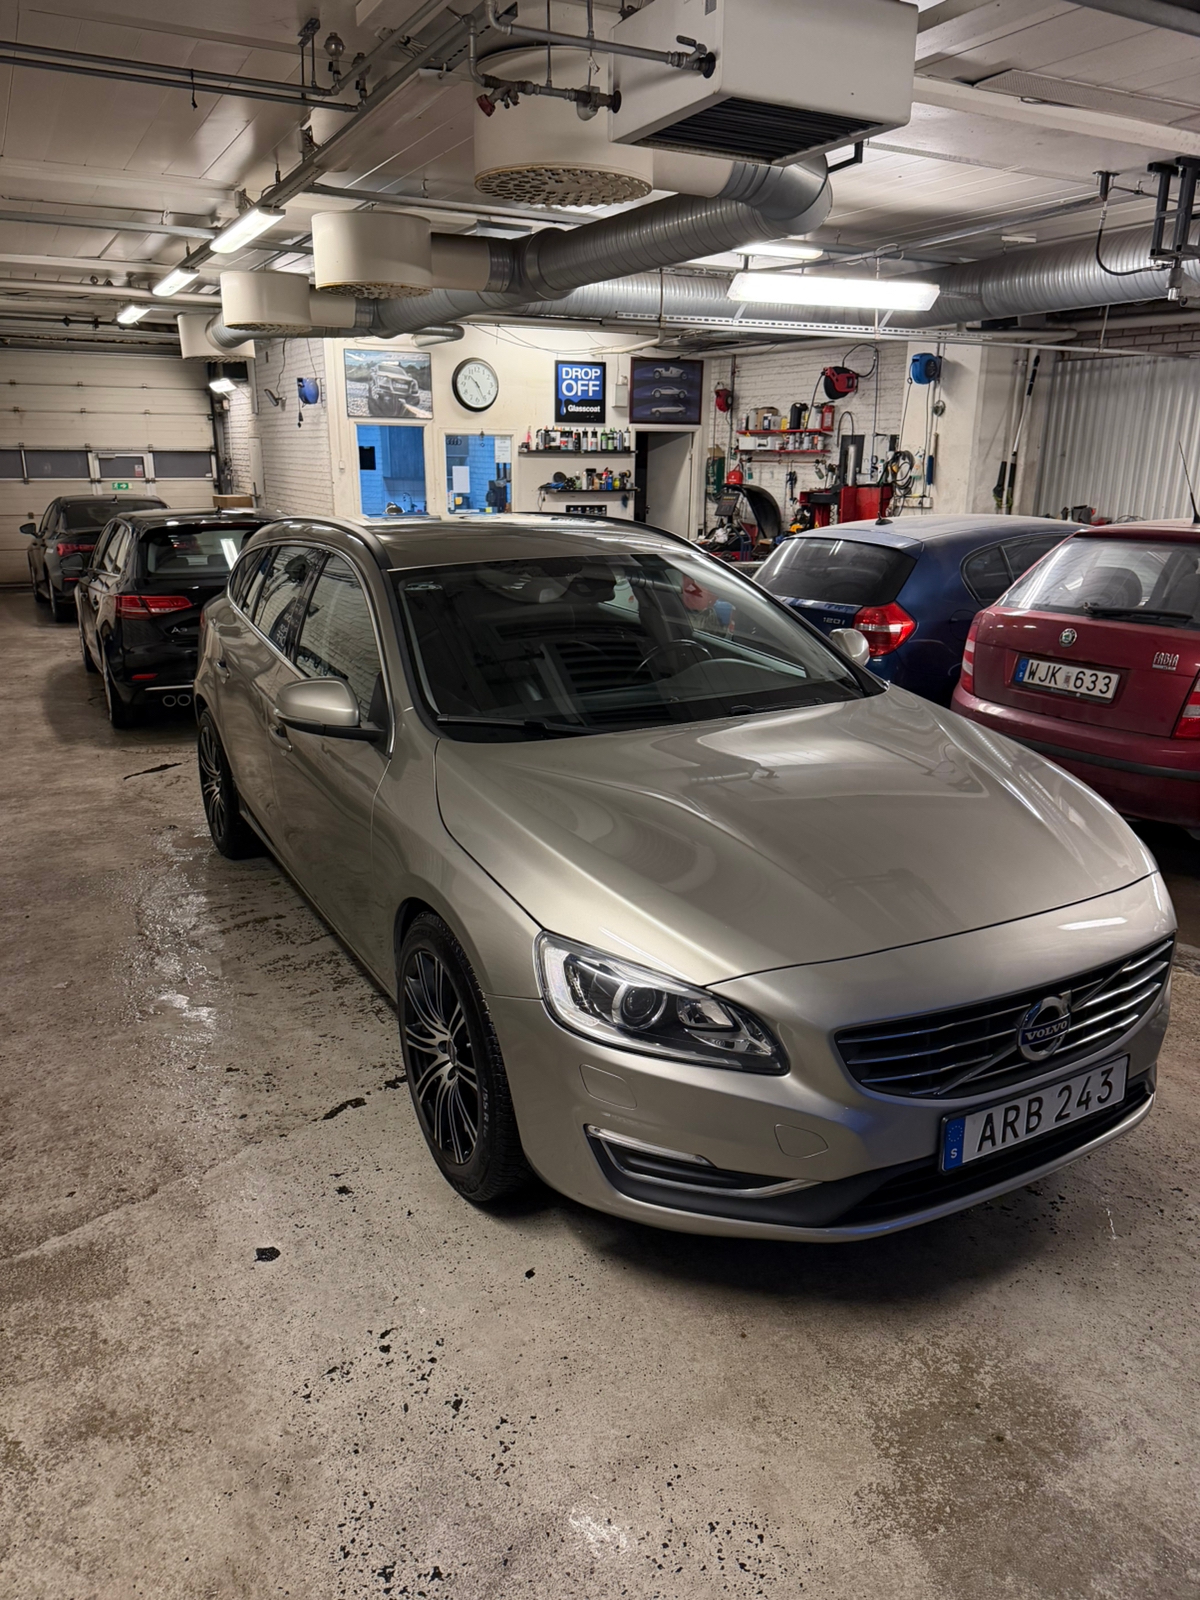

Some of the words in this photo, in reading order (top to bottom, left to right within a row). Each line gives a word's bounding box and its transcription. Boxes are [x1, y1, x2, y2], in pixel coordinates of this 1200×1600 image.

[562, 367, 601, 380] DROP
[561, 380, 600, 397] OFF
[567, 404, 601, 413] Glasscoat
[1153, 651, 1180, 667] FABIA
[1027, 662, 1063, 686] WJK
[1073, 670, 1112, 695] 633
[1025, 1020, 1068, 1041] VOLVO
[950, 1148, 958, 1159] S
[976, 1096, 1044, 1153] ARB
[1055, 1066, 1114, 1122] 243
